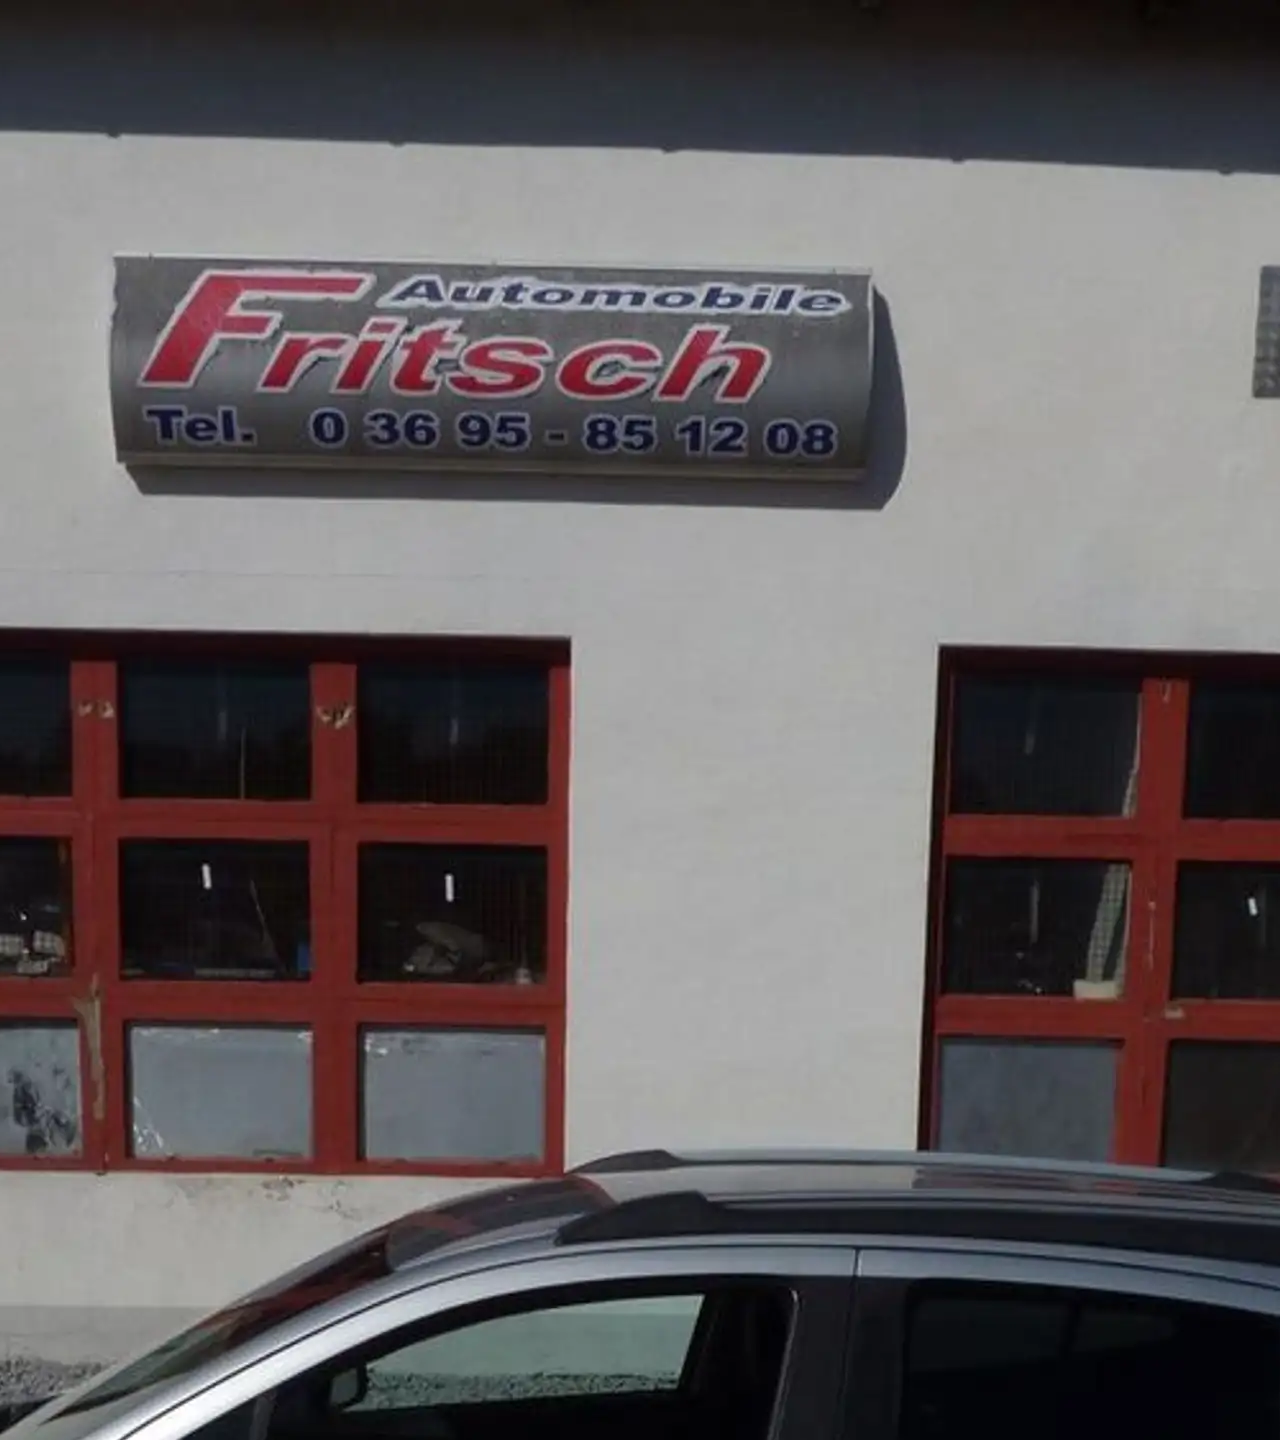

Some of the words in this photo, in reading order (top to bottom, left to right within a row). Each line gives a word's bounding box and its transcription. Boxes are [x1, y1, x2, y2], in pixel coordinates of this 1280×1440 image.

[380, 276, 850, 314] Automobile
[138, 271, 769, 402] Fritsch
[145, 407, 256, 443] Tel.
